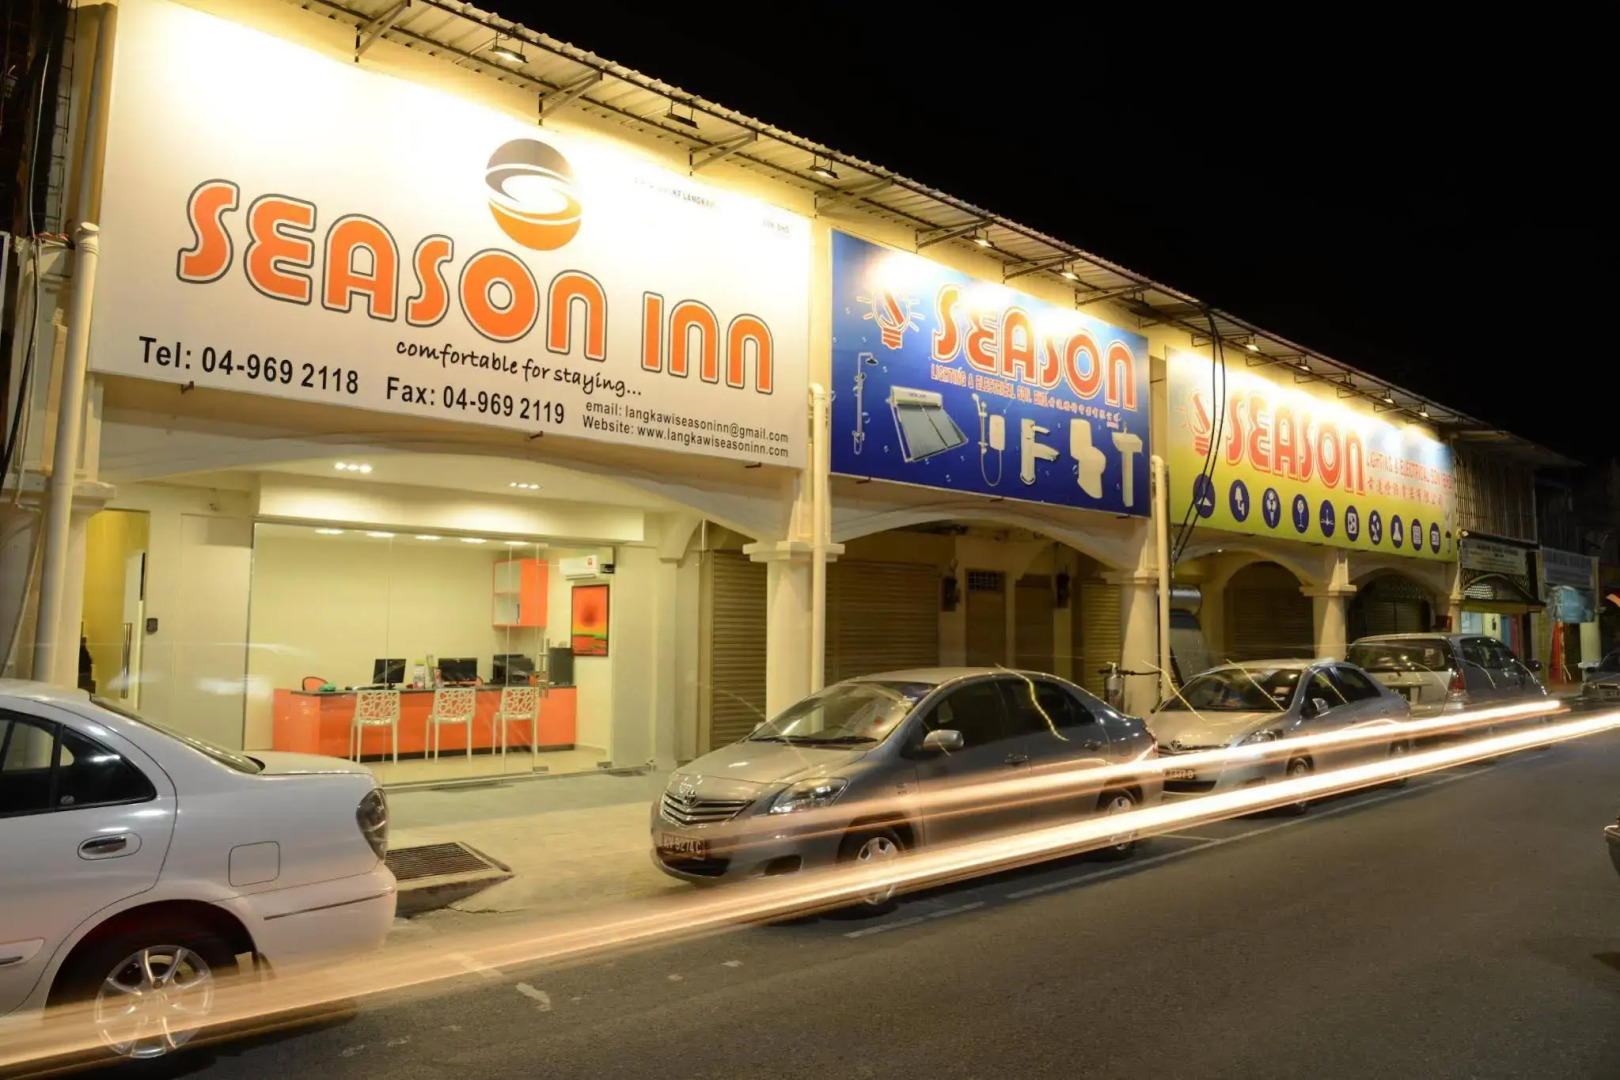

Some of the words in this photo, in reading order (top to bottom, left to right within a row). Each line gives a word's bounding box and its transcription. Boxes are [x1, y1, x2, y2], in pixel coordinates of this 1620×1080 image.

[176, 178, 607, 362] SEASON
[641, 291, 774, 395] INN
[138, 336, 192, 369] Tel:
[201, 346, 294, 385] 04-969
[301, 363, 359, 394] 2118
[396, 340, 518, 376] comfortable
[521, 358, 551, 382] for
[553, 364, 643, 399] staying...
[931, 364, 967, 387] LIGHTING
[932, 284, 1137, 411] SEASON
[386, 376, 435, 406] Fax:
[442, 385, 514, 417] 04-969
[519, 398, 565, 425] 2119
[585, 401, 623, 417] email:
[625, 404, 789, 443] langkawiseasoninn@gmail.com
[582, 414, 634, 435] Website:
[637, 425, 789, 457] www.langkawiseasoninn.com
[1226, 394, 1366, 496] SEASON
